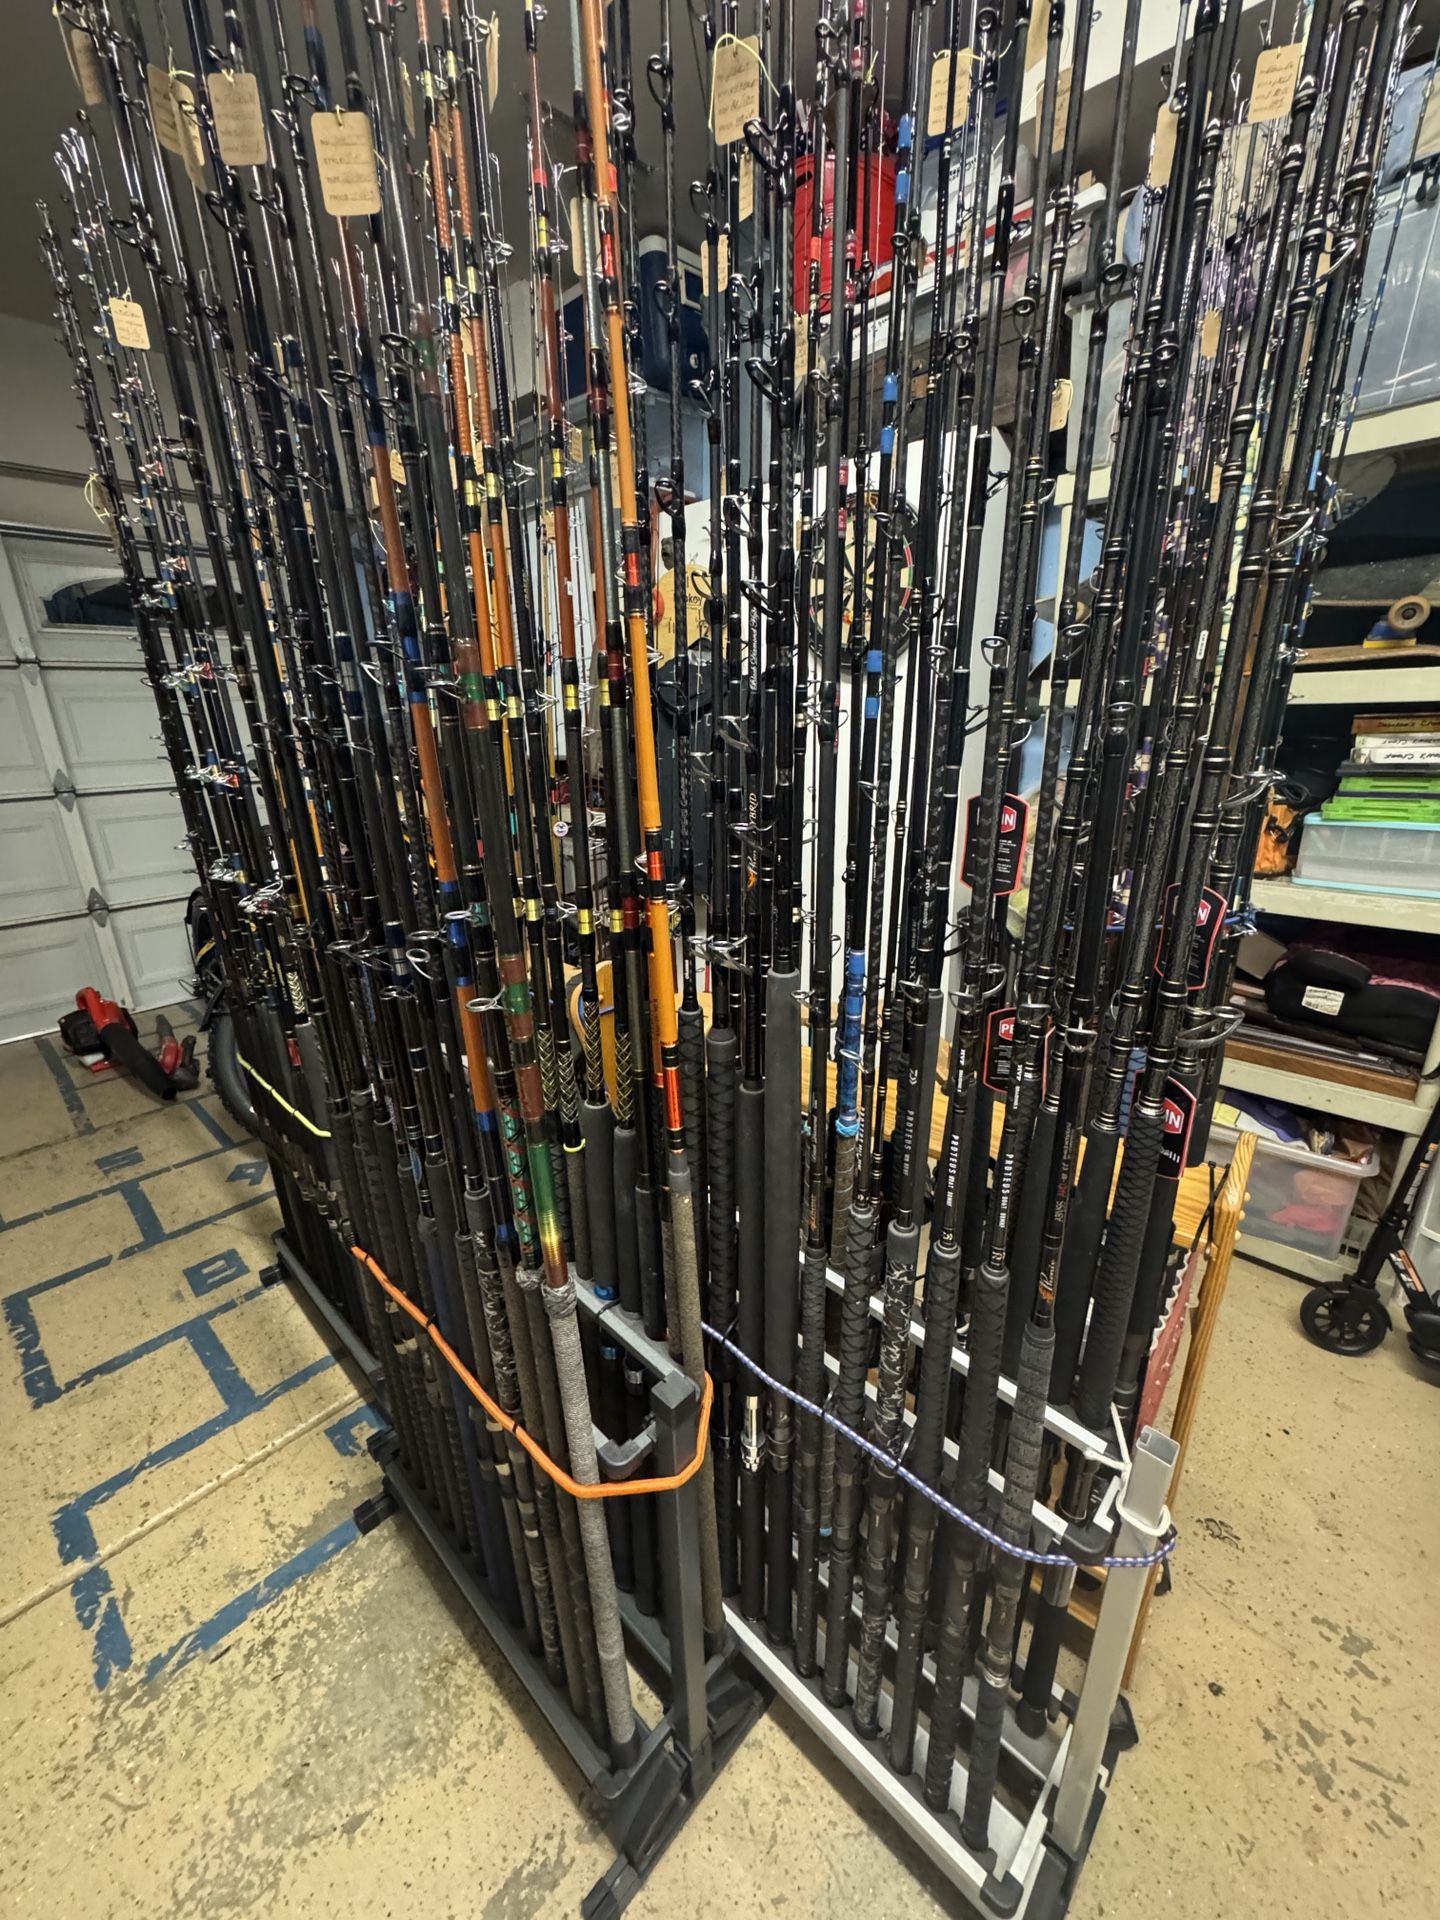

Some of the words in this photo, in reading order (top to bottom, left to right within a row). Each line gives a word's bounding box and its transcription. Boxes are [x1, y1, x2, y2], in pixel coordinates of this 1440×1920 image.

[748, 792, 759, 827] YBRID
[904, 1109, 915, 1151] PROTEUS
[948, 1134, 960, 1174] PROTEUS
[1001, 1153, 1015, 1194] PROTEUS
